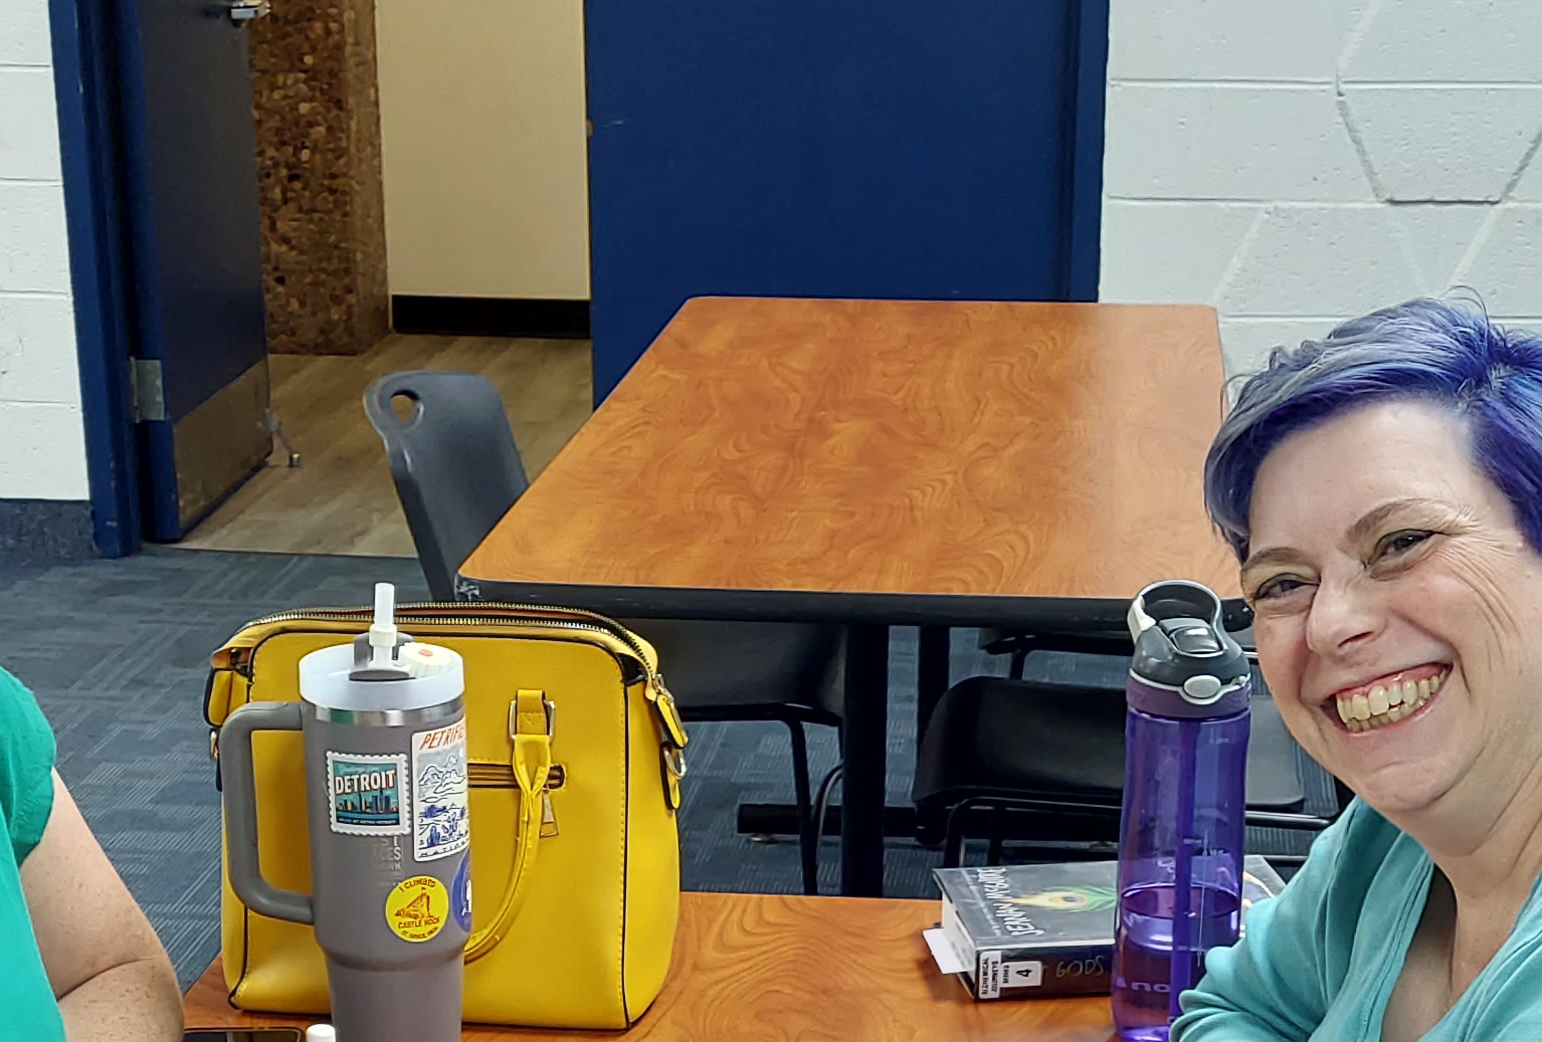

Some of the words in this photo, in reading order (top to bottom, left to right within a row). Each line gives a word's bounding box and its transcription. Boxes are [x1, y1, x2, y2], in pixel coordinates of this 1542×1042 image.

[335, 769, 395, 795] DETROIT
[1016, 968, 1032, 978] 4
[1056, 955, 1105, 978] GODS
